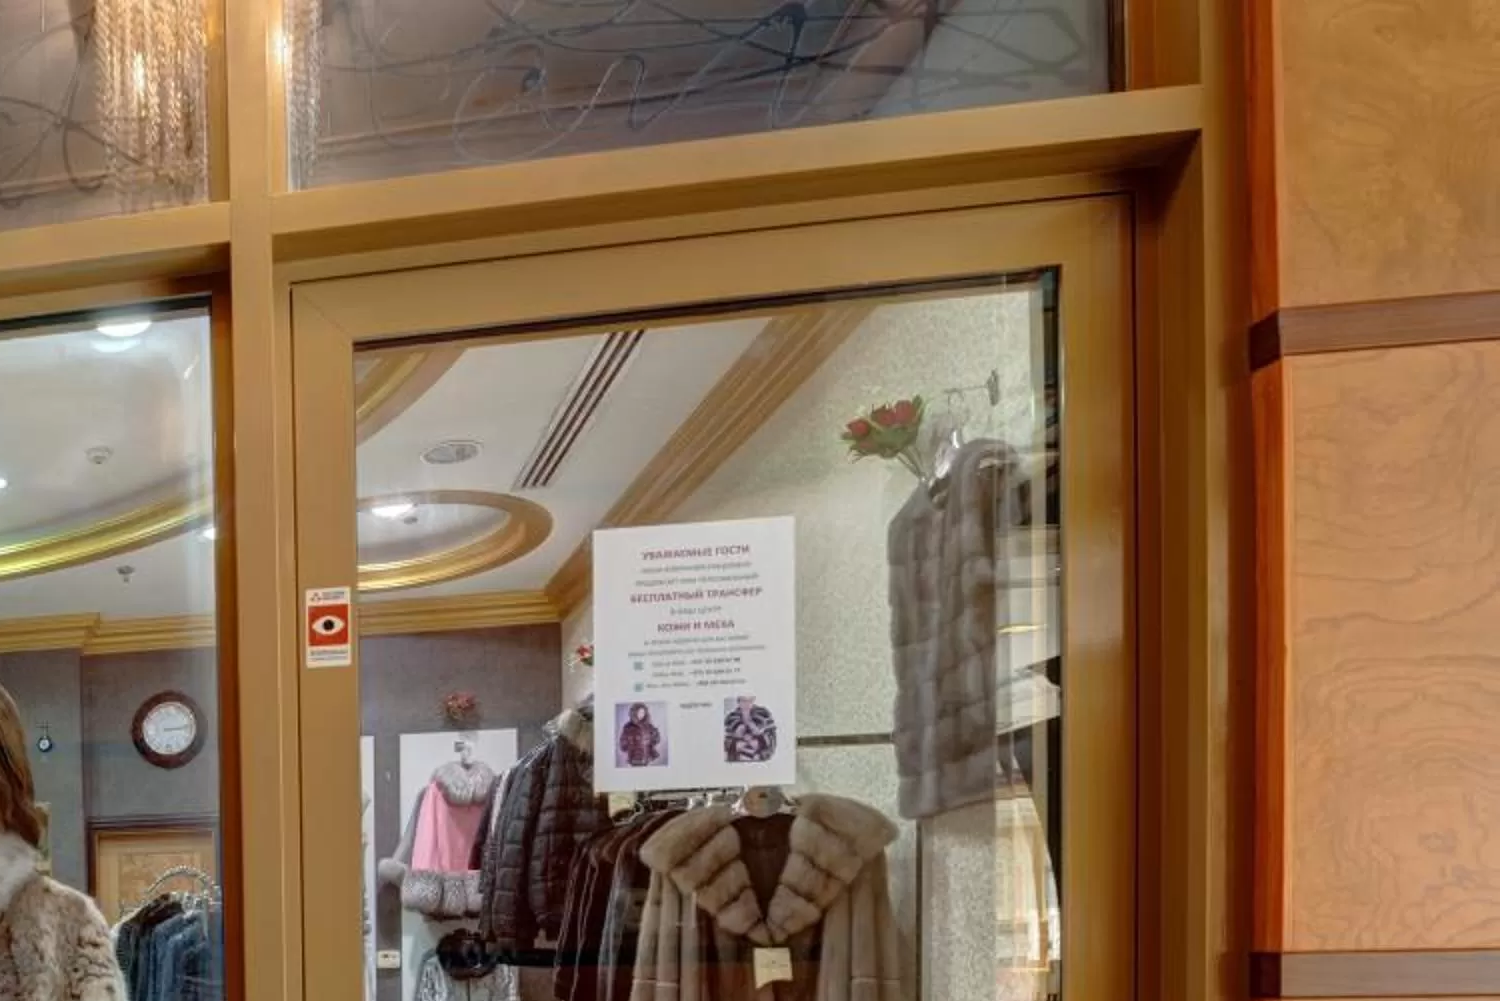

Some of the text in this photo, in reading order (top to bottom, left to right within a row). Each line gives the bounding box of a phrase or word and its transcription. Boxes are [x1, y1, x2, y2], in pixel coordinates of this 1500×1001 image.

[641, 544, 750, 560] УВАЖАЕМЫЕ ГОСТИ
[630, 585, 763, 603] БЕСПЛАТНЫЙ ТРАНСФЕР
